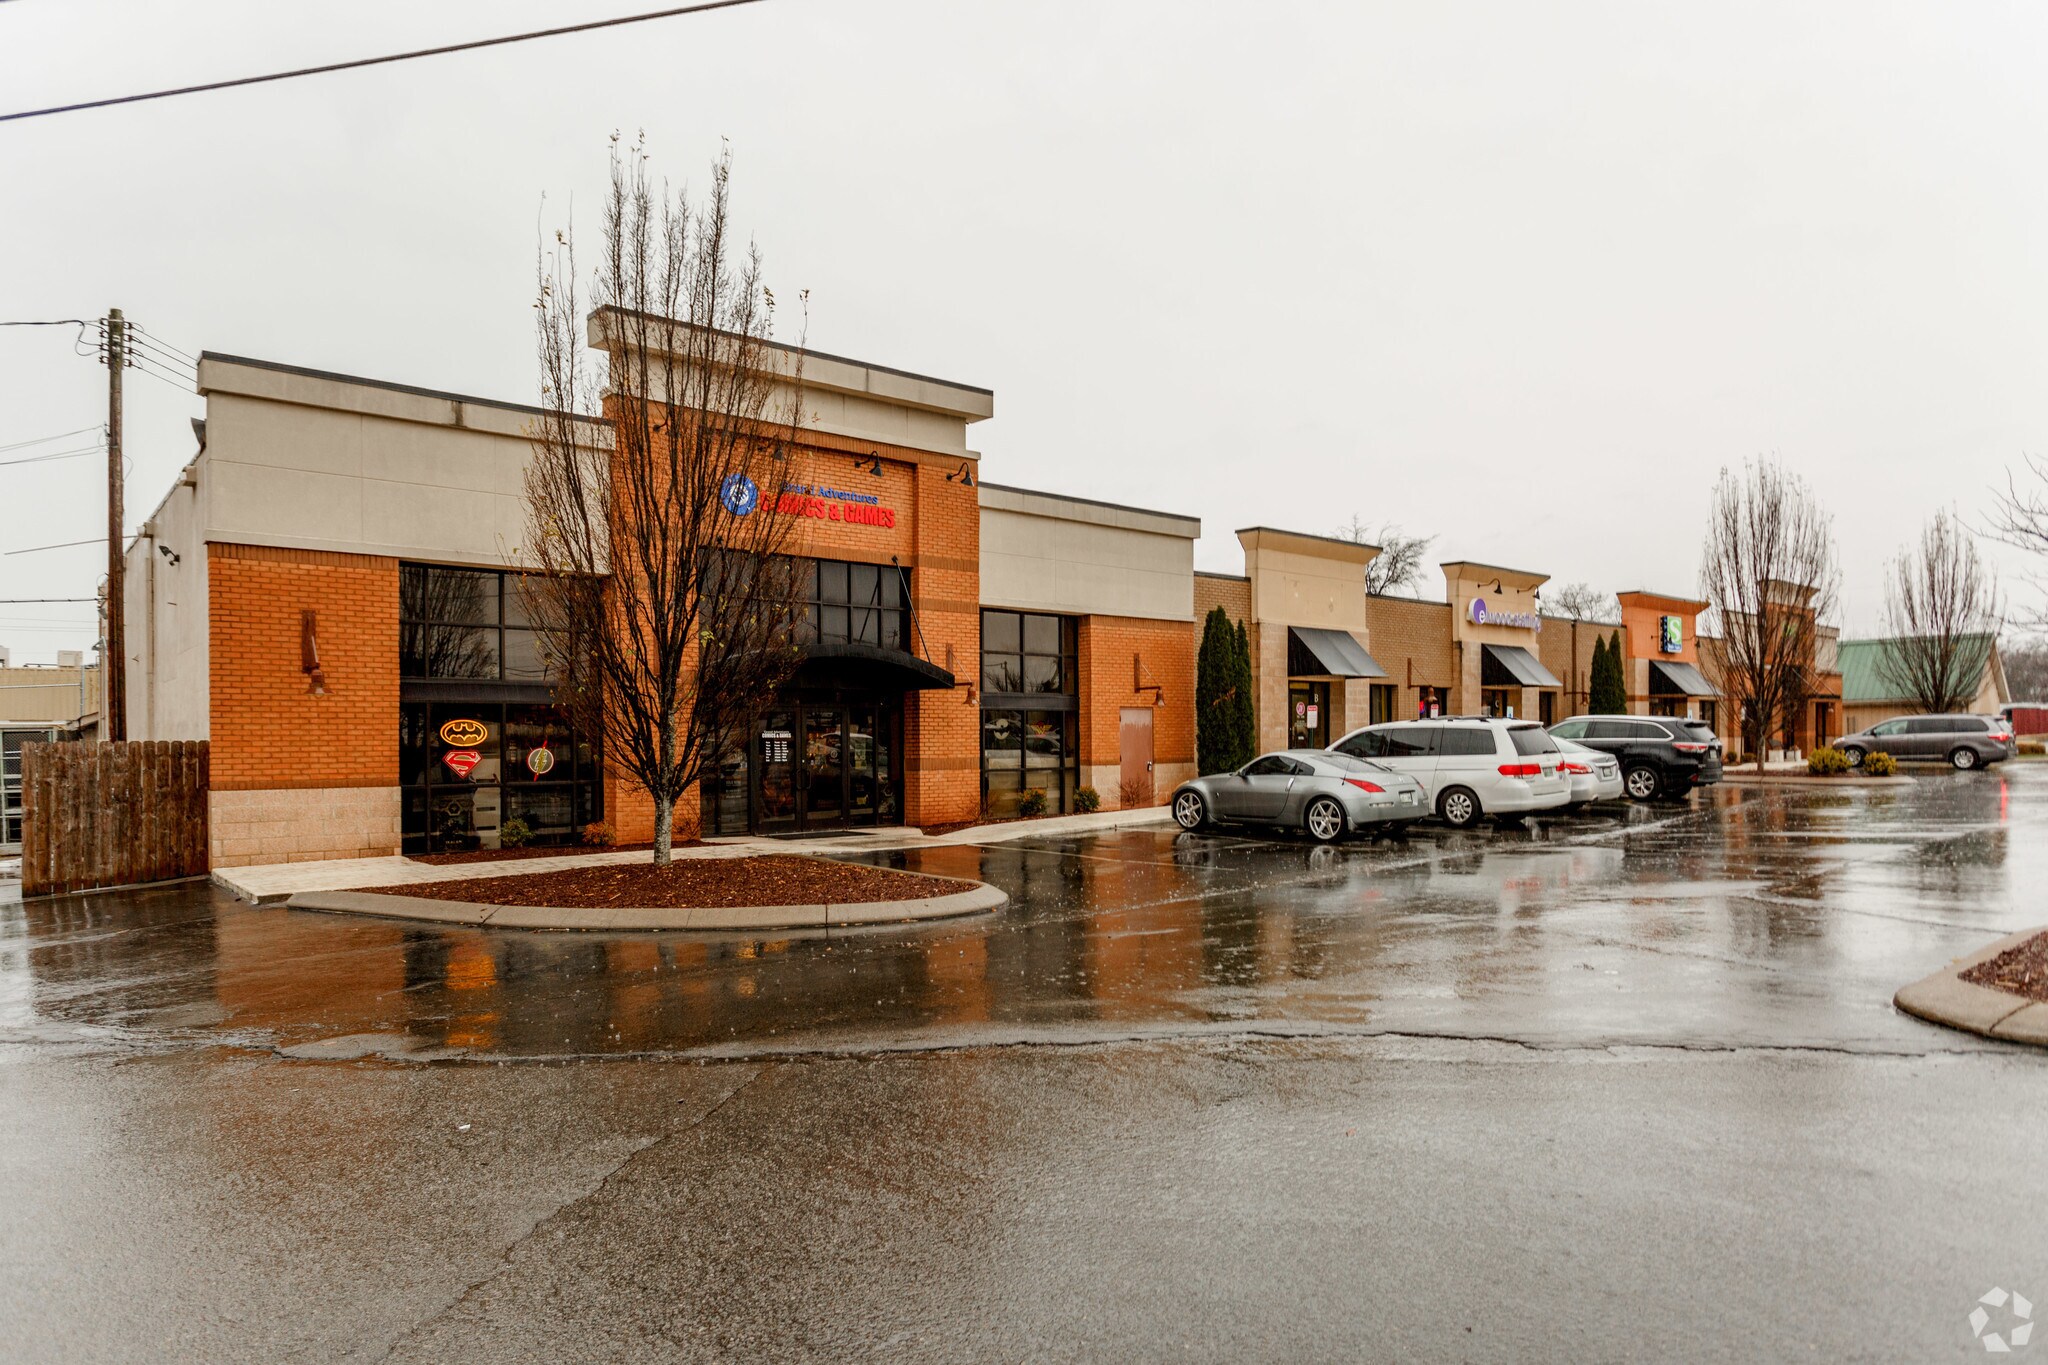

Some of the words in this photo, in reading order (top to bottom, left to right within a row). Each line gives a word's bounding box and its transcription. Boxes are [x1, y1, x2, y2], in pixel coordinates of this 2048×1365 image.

[818, 486, 878, 504] Adventures
[829, 504, 840, 521] &
[843, 503, 896, 528] GAMES
